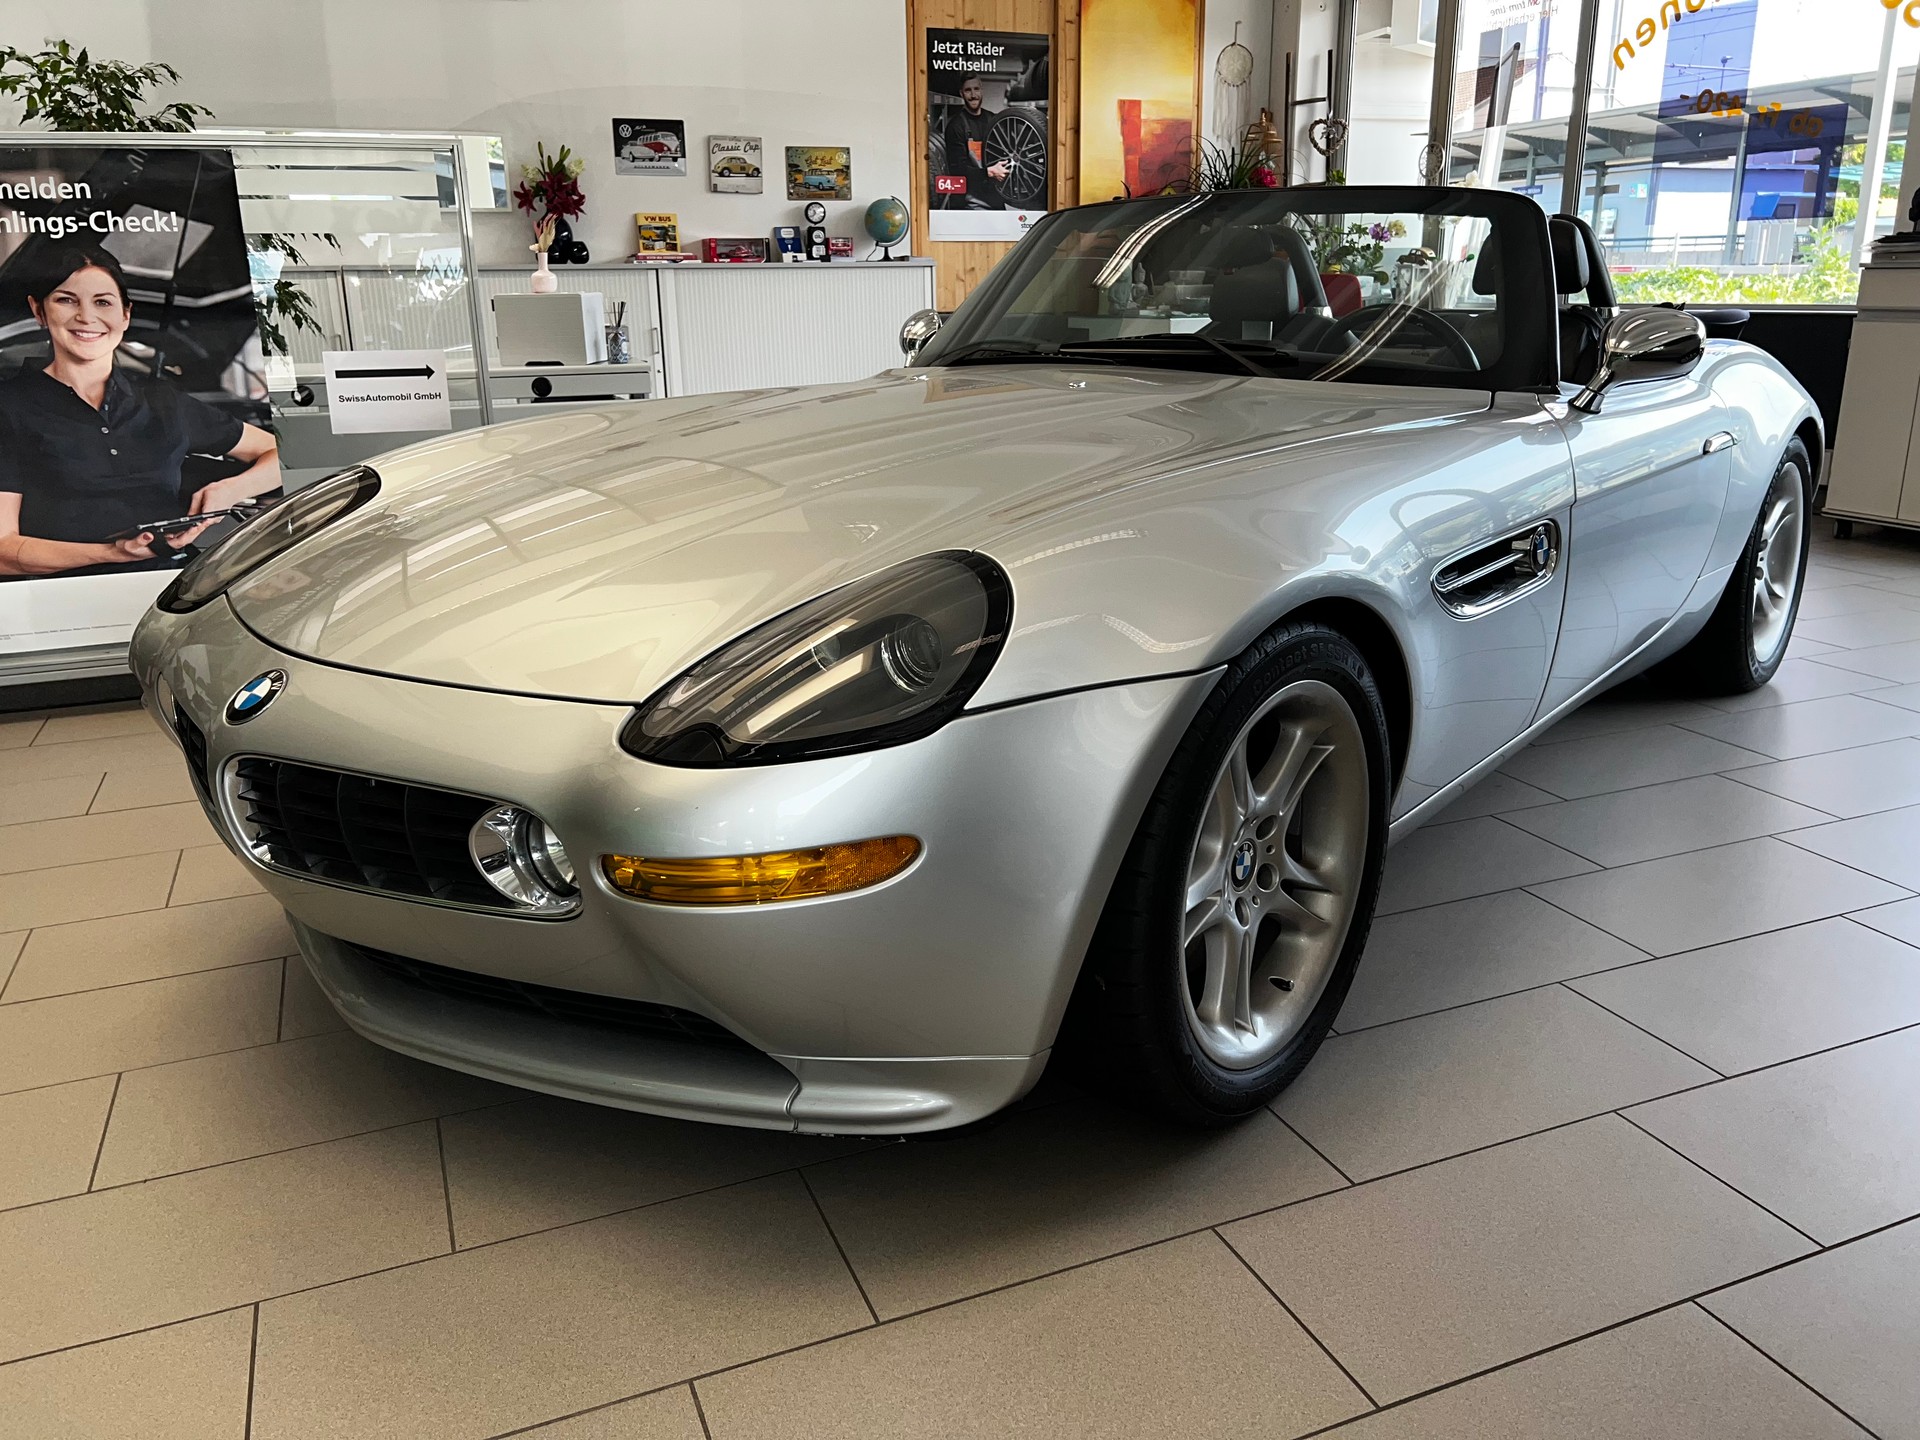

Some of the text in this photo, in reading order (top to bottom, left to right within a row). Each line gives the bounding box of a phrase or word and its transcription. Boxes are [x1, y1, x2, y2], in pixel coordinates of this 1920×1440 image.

[932, 40, 1005, 56] Jetzt Räder
[932, 56, 997, 72] wechseln!
[712, 141, 760, 154] Classic Cup
[338, 392, 442, 403] SwissAutomobil GmbH
